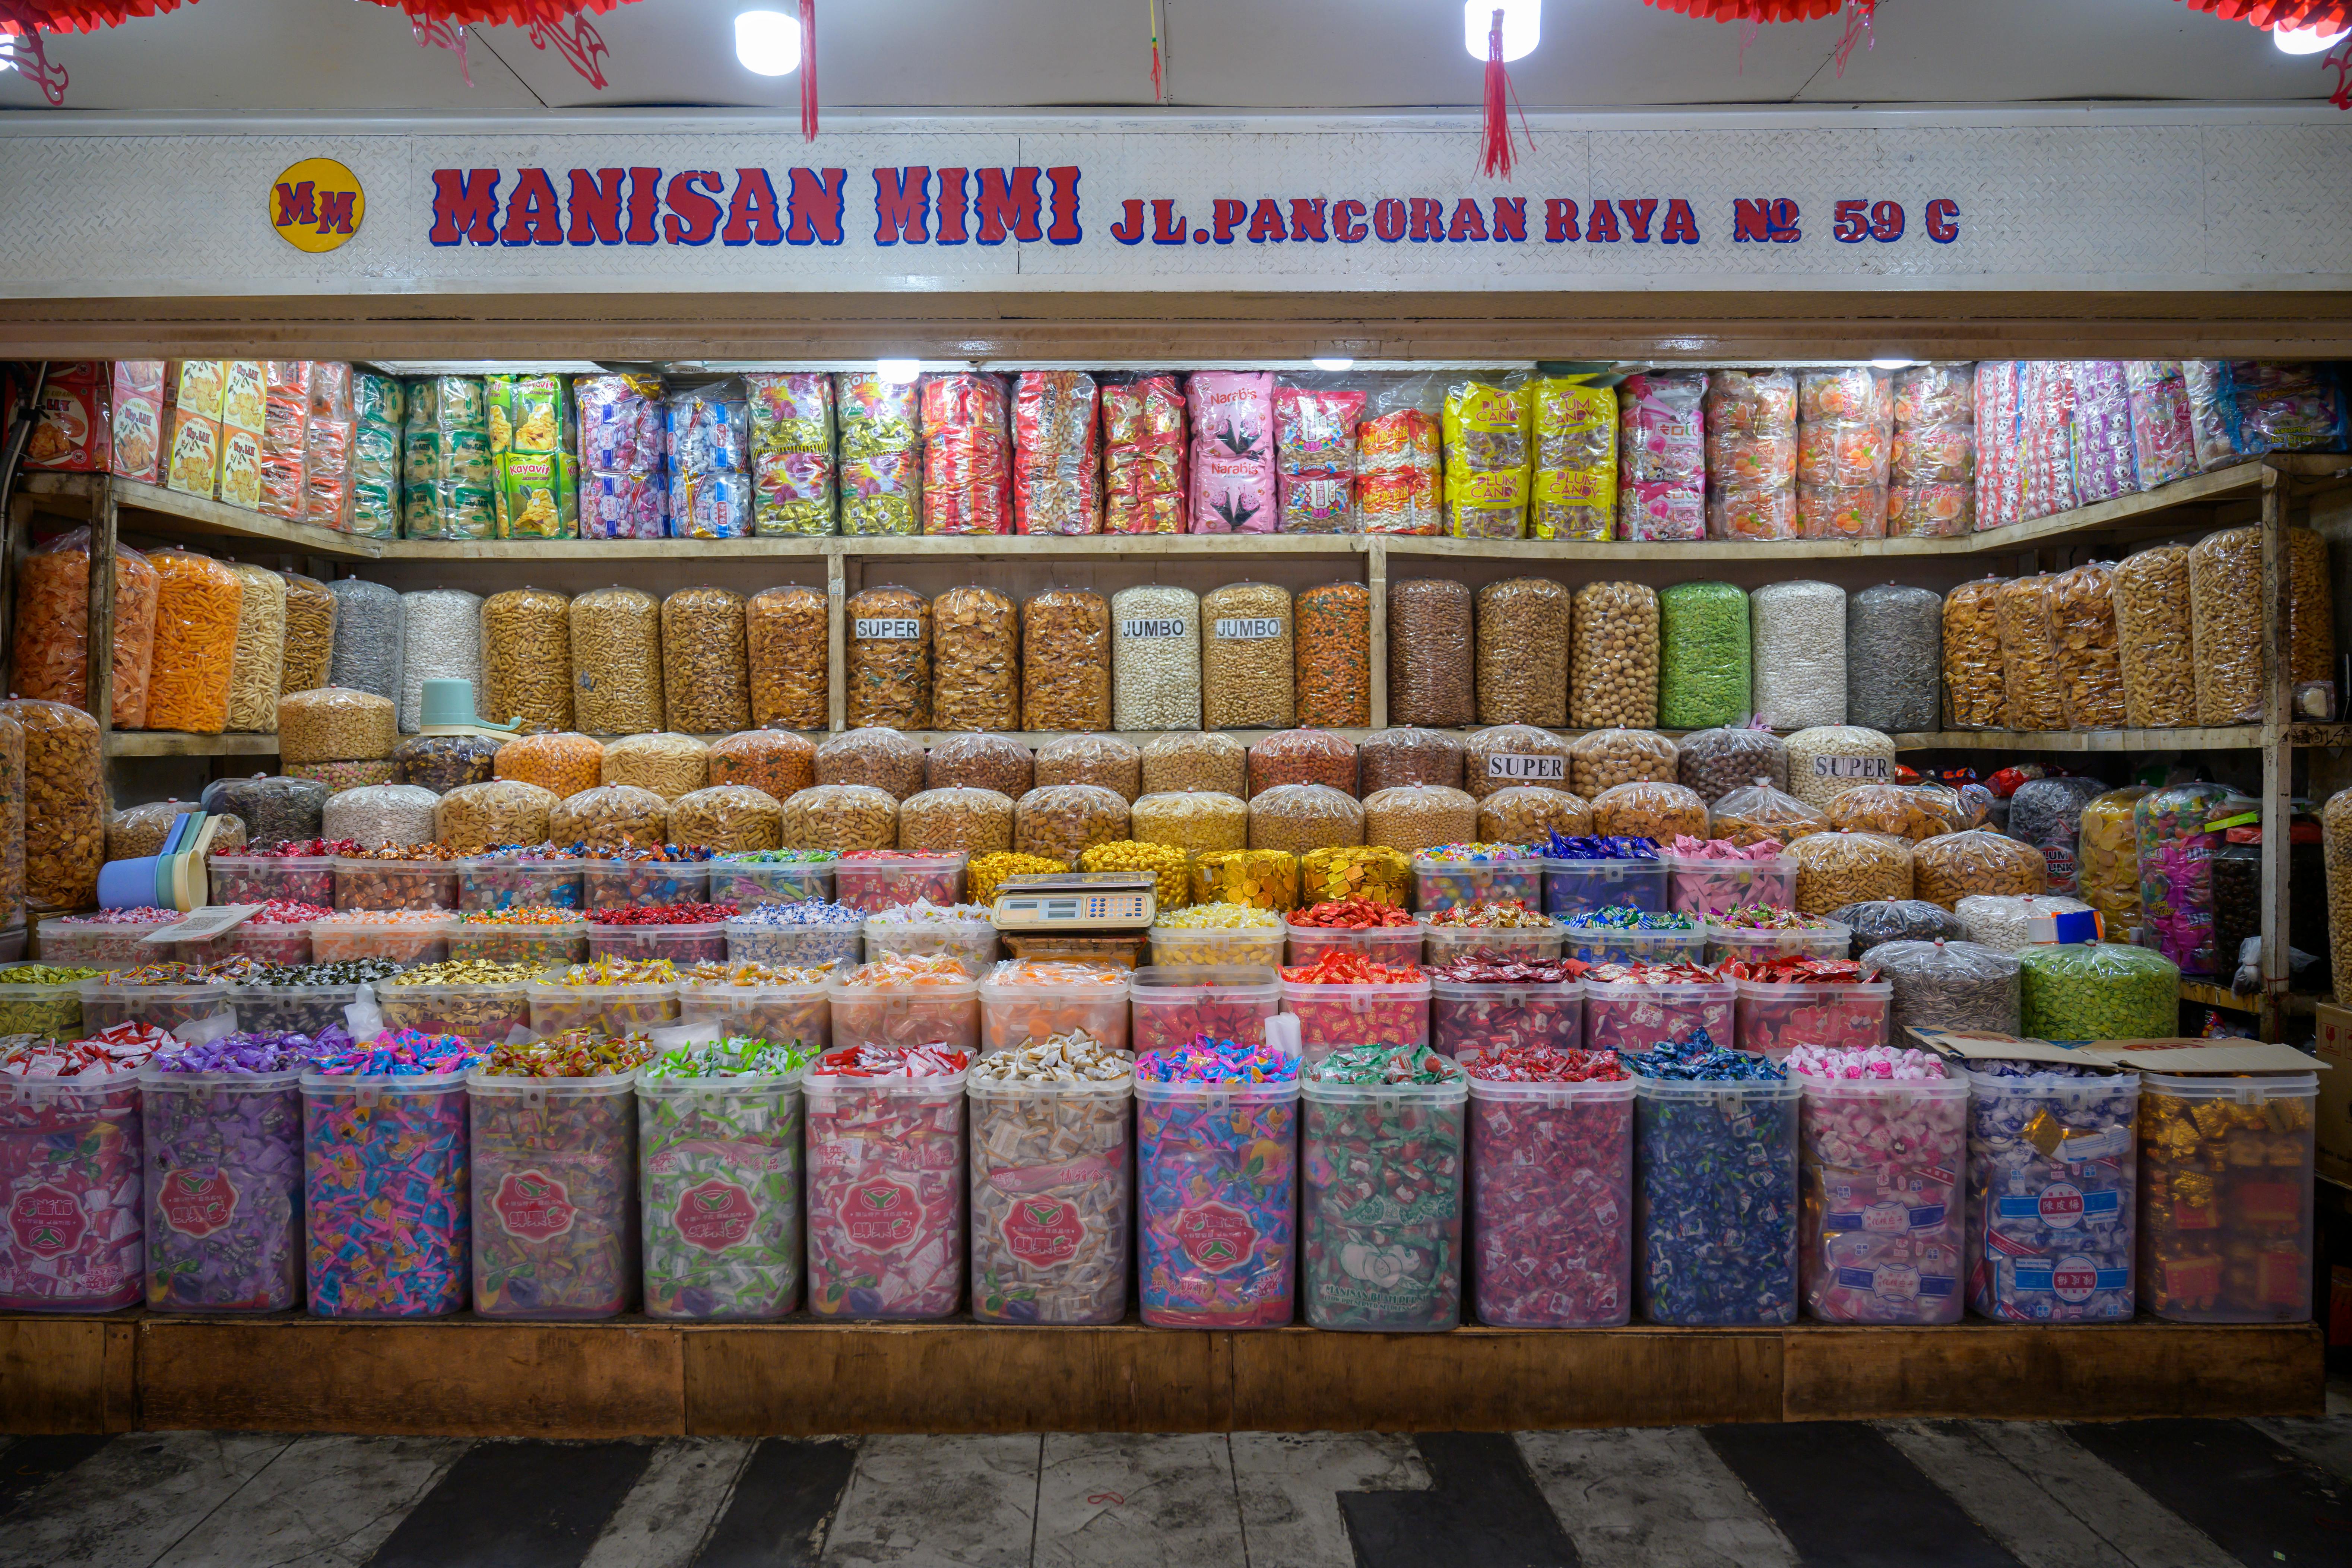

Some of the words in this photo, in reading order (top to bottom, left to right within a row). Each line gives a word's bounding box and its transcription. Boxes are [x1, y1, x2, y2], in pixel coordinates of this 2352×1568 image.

[429, 167, 848, 247] MANISAN
[872, 166, 1082, 247] MIMI
[1545, 199, 1700, 244] RAYA
[1833, 199, 1905, 244] 59
[237, 363, 260, 381] Ny.LIZ
[1210, 387, 1257, 406] Narabis
[1482, 399, 1519, 411] PLUM
[1547, 397, 1590, 414] PLUM
[125, 407, 153, 426] Ny.LIZ
[1043, 411, 1055, 437] Nuts
[1476, 411, 1524, 422] CANDY
[1544, 407, 1596, 426] CANDY
[186, 425, 211, 444] Ny.LIZ
[2273, 425, 2311, 435] Assorted
[234, 440, 255, 457] Ny.LIZ
[510, 464, 550, 476] Kayavit
[1211, 462, 1258, 475] Narabis
[1477, 475, 1516, 487] PLUM
[1556, 471, 1597, 487] PLUM
[1471, 486, 1520, 498] CANDY
[1550, 483, 1601, 498] CANDY
[858, 621, 917, 637] SUPER
[1123, 620, 1184, 637] JUMBO
[1218, 620, 1279, 636] JUMBO
[1491, 757, 1562, 776] SUPER
[1816, 756, 1887, 777] SUPER
[2044, 850, 2069, 861] LUM
[2047, 862, 2074, 873] UNK
[439, 1026, 480, 1035] JAMIN
[2042, 1198, 2080, 1212] 陳皮梅
[852, 1217, 912, 1239] 鲜果多
[1013, 1235, 1075, 1256] 鲜果多
[2057, 1274, 2093, 1286] 陳皮梅
[1325, 1284, 1370, 1301] MANISAN
[1341, 1298, 1378, 1308] PRESERVED
